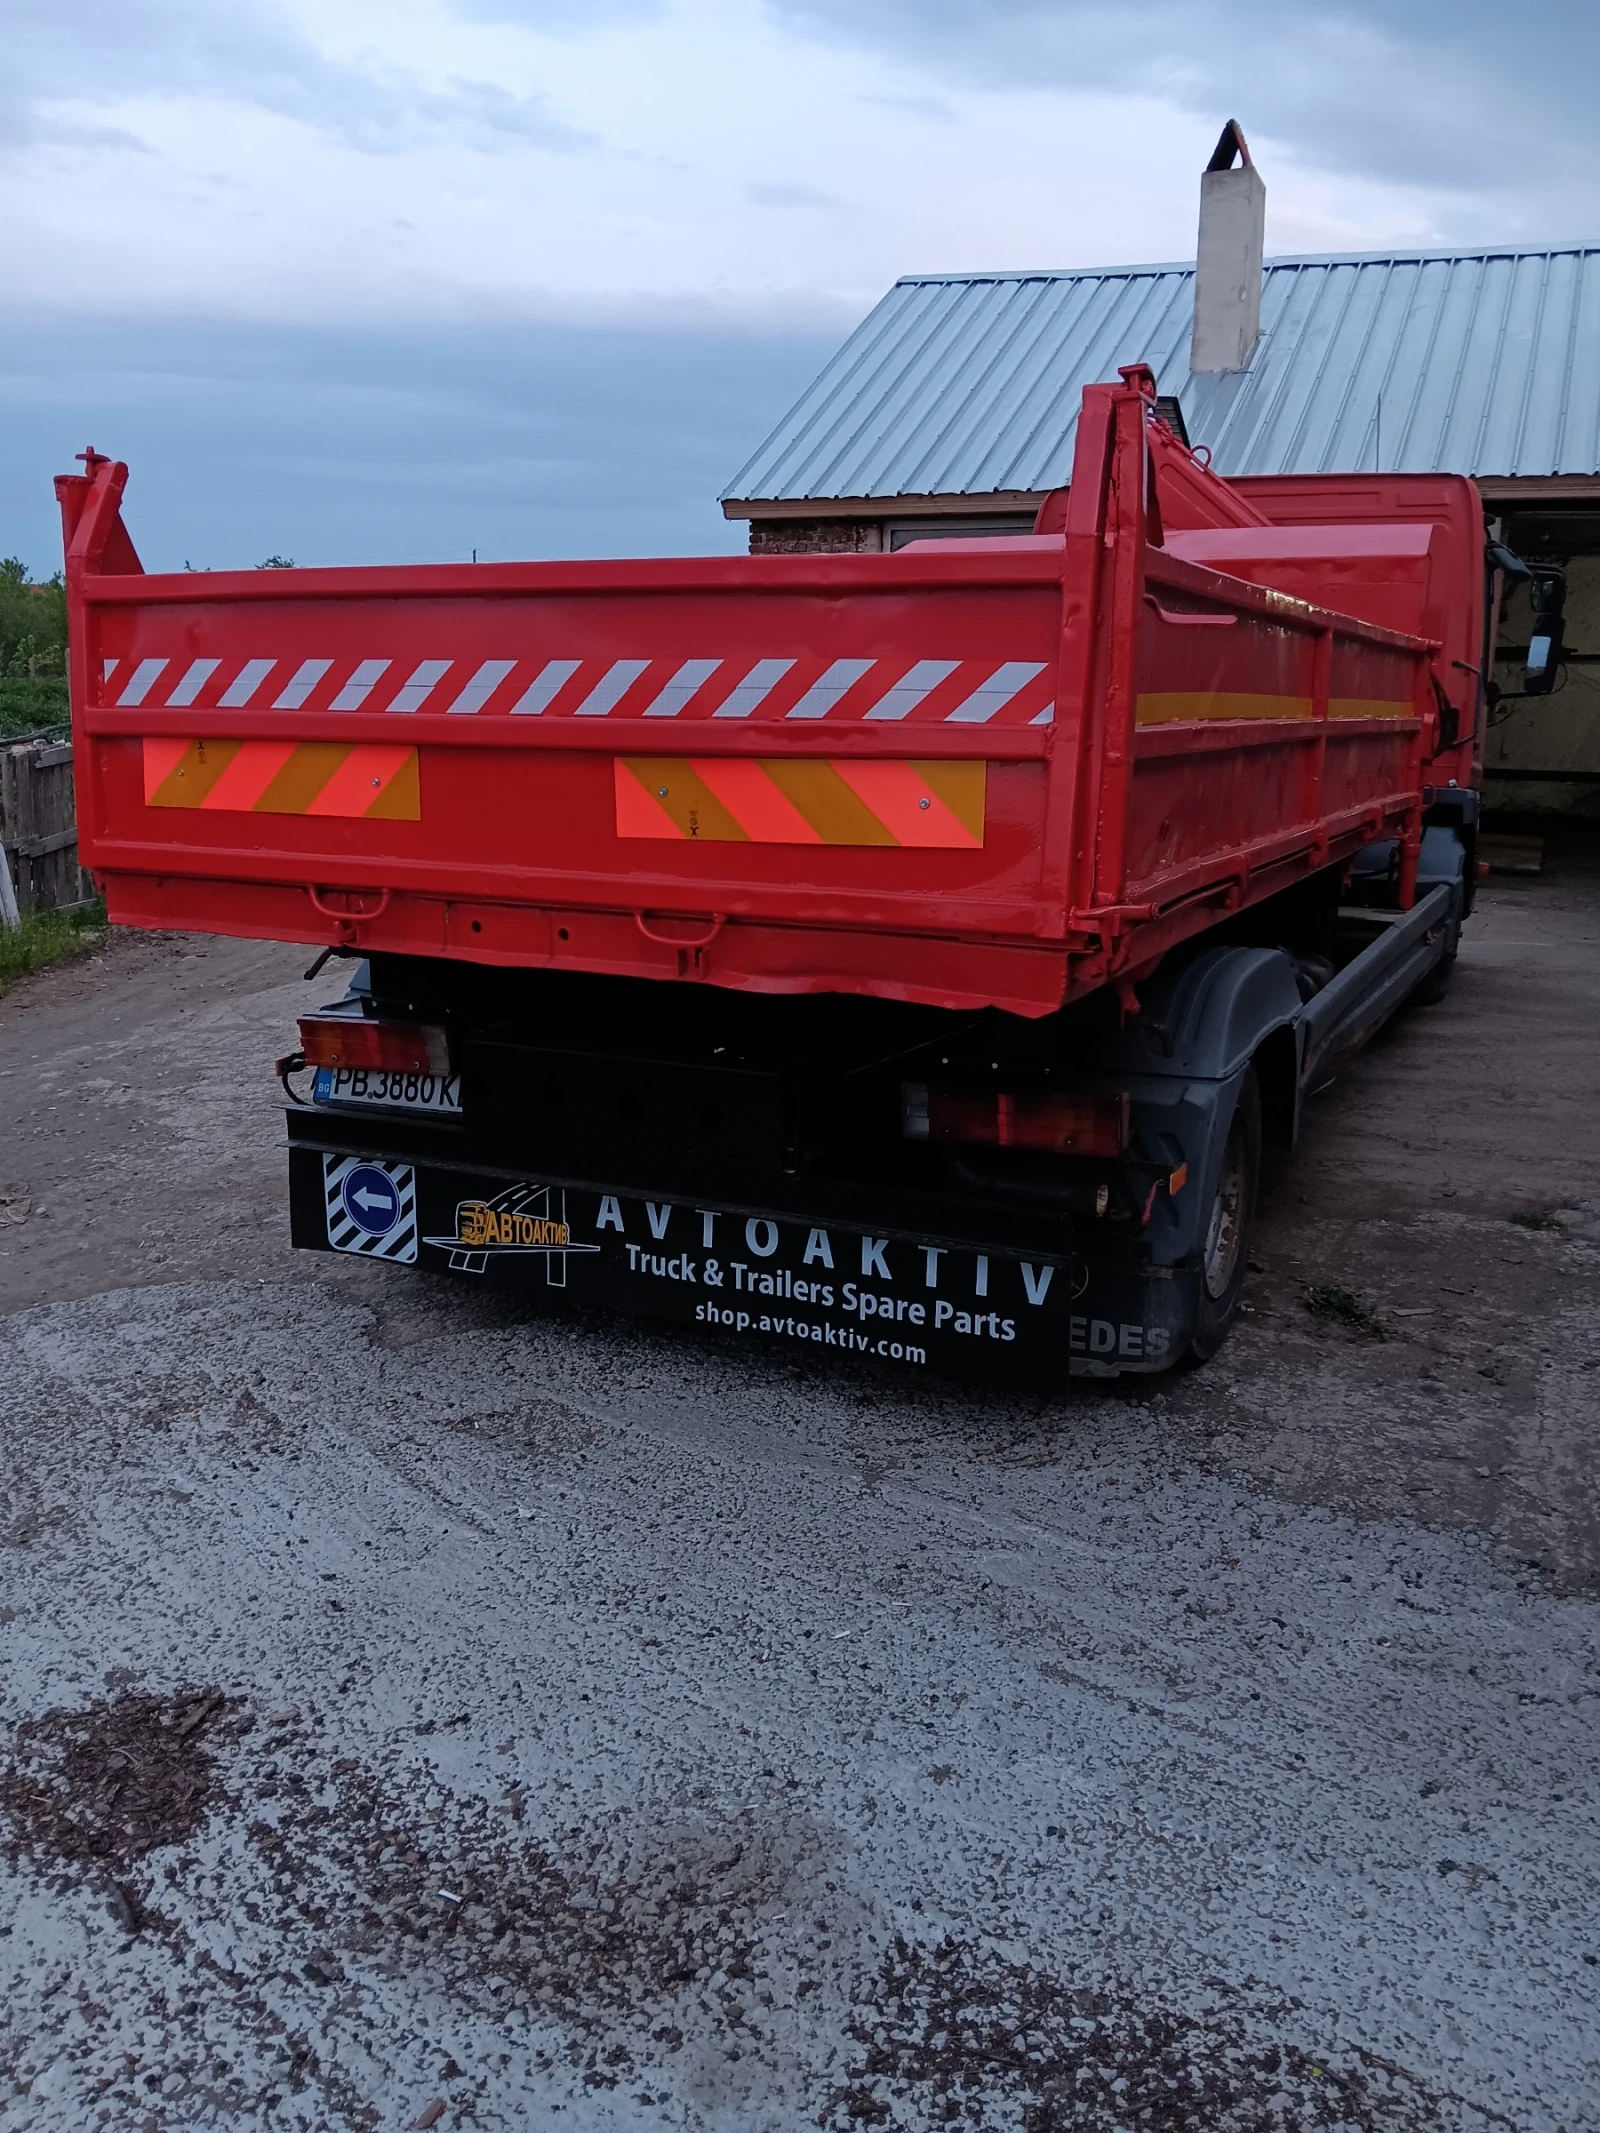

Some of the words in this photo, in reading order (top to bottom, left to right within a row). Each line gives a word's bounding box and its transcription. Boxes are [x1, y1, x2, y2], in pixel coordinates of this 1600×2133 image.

[317, 1082, 331, 1093] BG
[440, 1075, 462, 1109] K
[485, 1211, 569, 1246] АВТОАКТИВ
[595, 1195, 1055, 1306] AVTOAKTIV
[626, 1243, 697, 1283] Truck
[703, 1258, 724, 1288] &
[731, 1263, 835, 1307] Trailers
[841, 1283, 926, 1325] Spare
[934, 1301, 1018, 1342] Parts
[695, 1303, 926, 1365] shop.avtoaktiv.com
[1069, 1316, 1171, 1357] EDES
